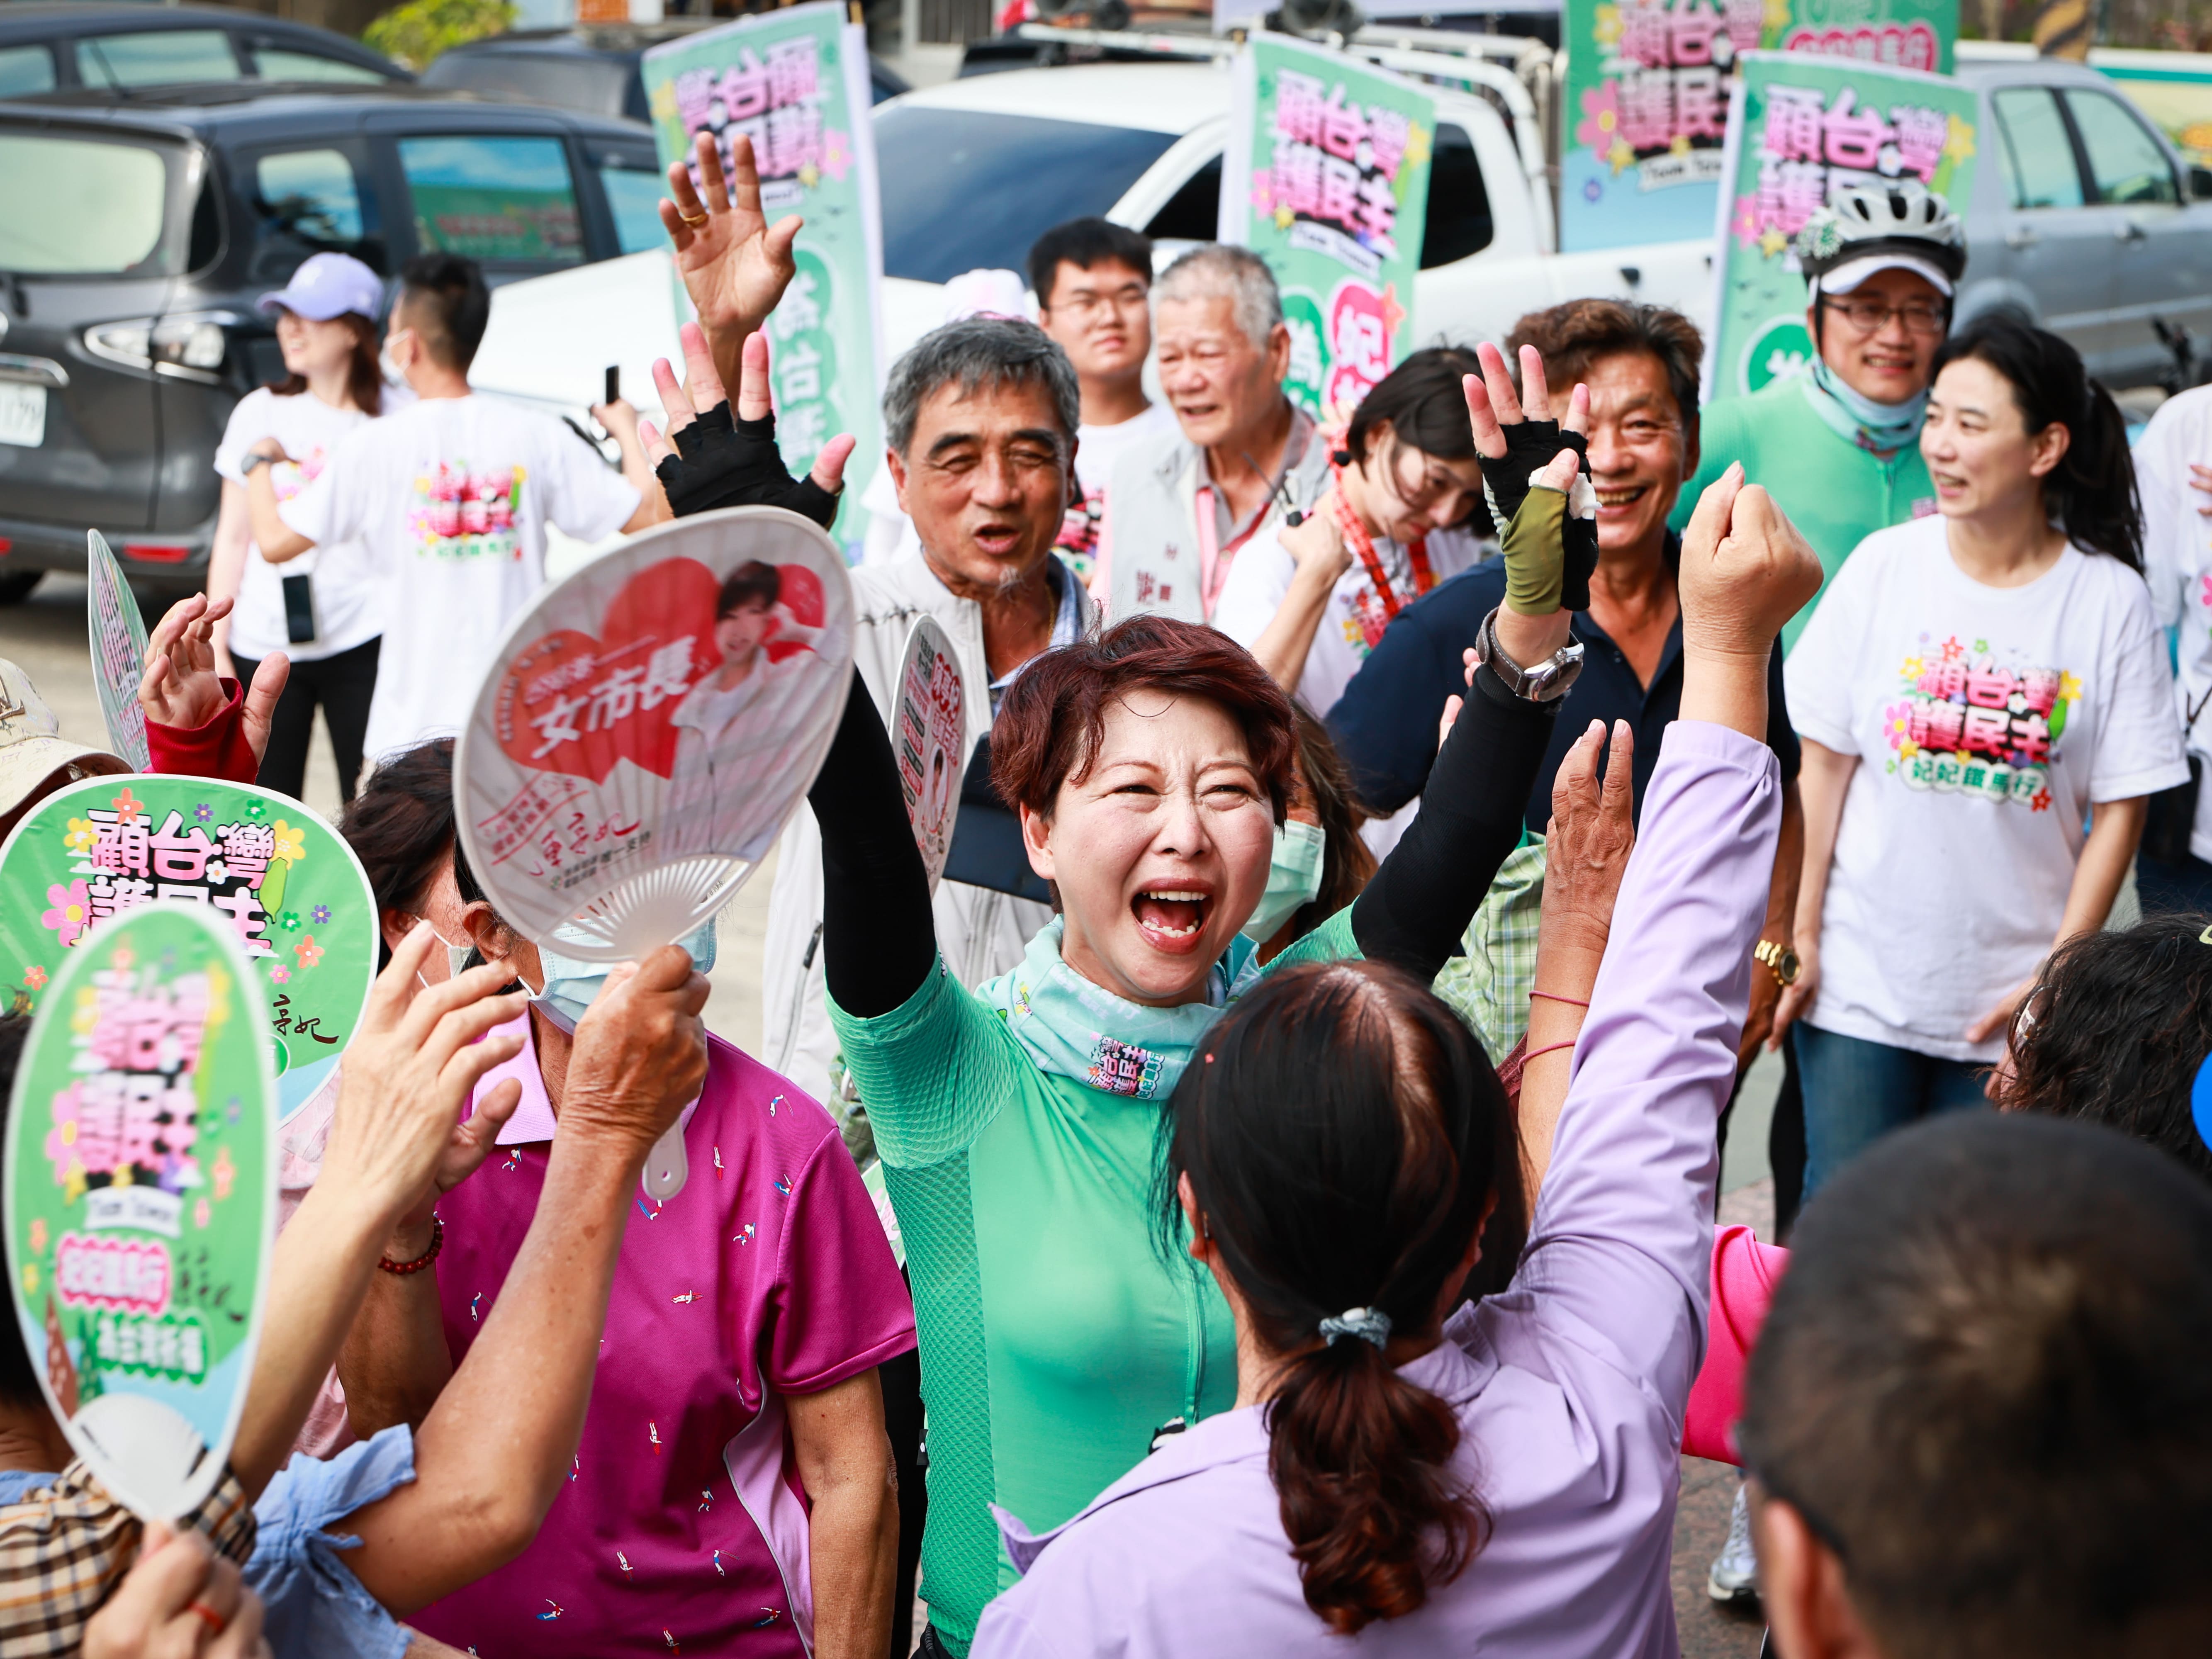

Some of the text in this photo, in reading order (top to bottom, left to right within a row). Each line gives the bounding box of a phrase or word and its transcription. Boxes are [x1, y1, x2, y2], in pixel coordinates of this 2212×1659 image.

[1617, 67, 1730, 149] 護民
[1764, 84, 1948, 182] 顧台灣
[530, 635, 696, 759] 女市長
[1917, 650, 2060, 719] 顧台灣
[1910, 697, 2051, 764] 護民主
[1912, 759, 2041, 797] 妃妃鐵馬行
[88, 809, 274, 889] 顧台灣
[1139, 1051, 1162, 1098] 妃妃鐵馬行
